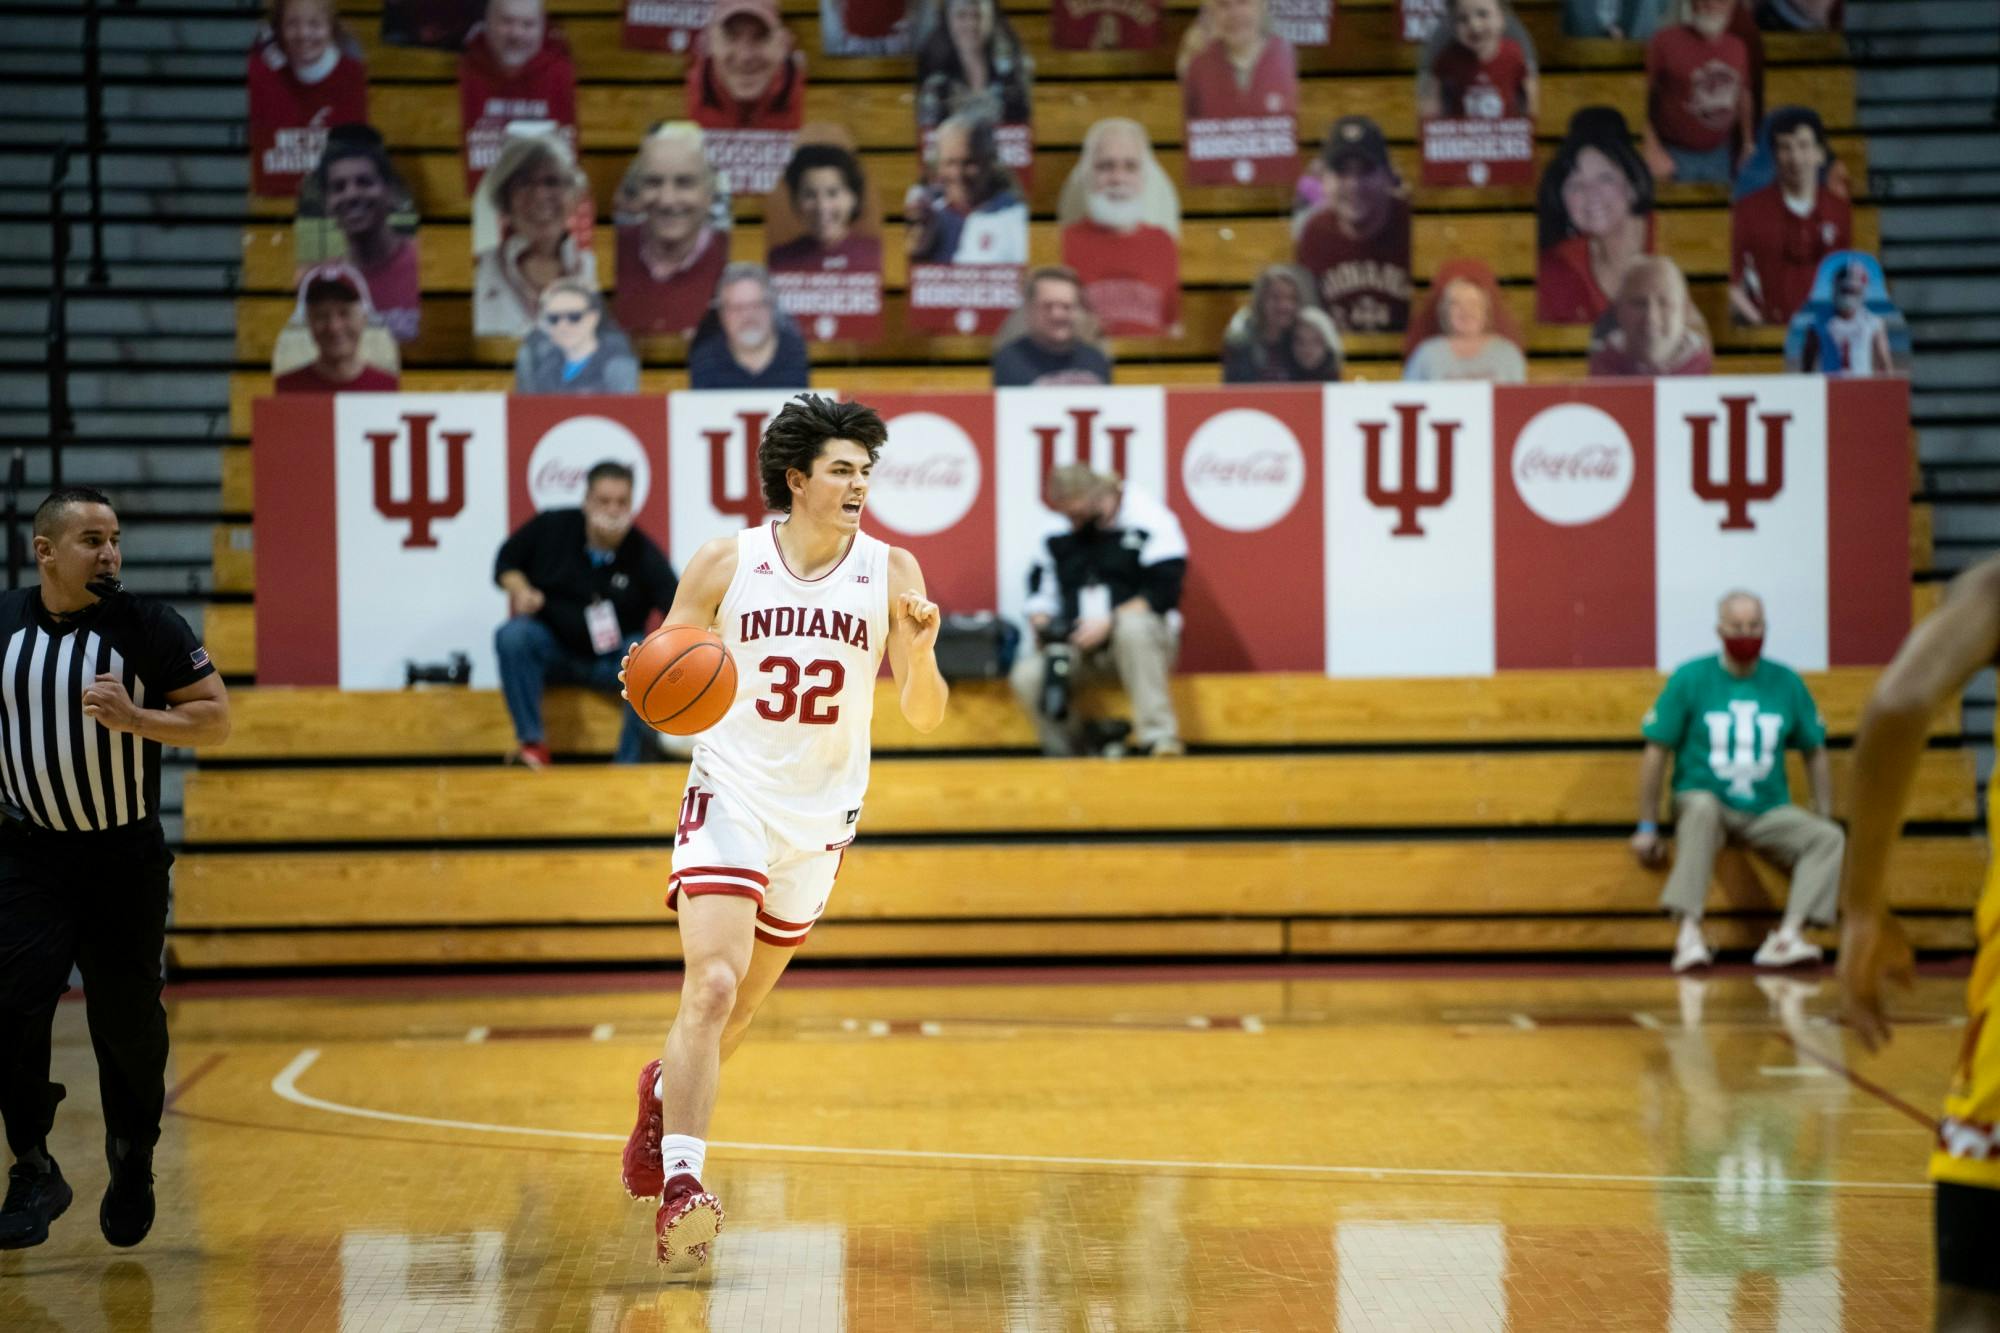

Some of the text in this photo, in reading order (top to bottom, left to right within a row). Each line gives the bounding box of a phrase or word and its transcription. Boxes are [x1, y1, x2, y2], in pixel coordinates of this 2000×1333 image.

[364, 413, 473, 548] IU
[1190, 451, 1292, 487] Coca-Cola
[1356, 404, 1462, 536] IU
[1520, 445, 1620, 483] Coca-Cola
[1684, 395, 1793, 531] IU
[740, 606, 870, 652] INDIANA
[755, 655, 845, 725] 32
[1704, 700, 1783, 799] IU
